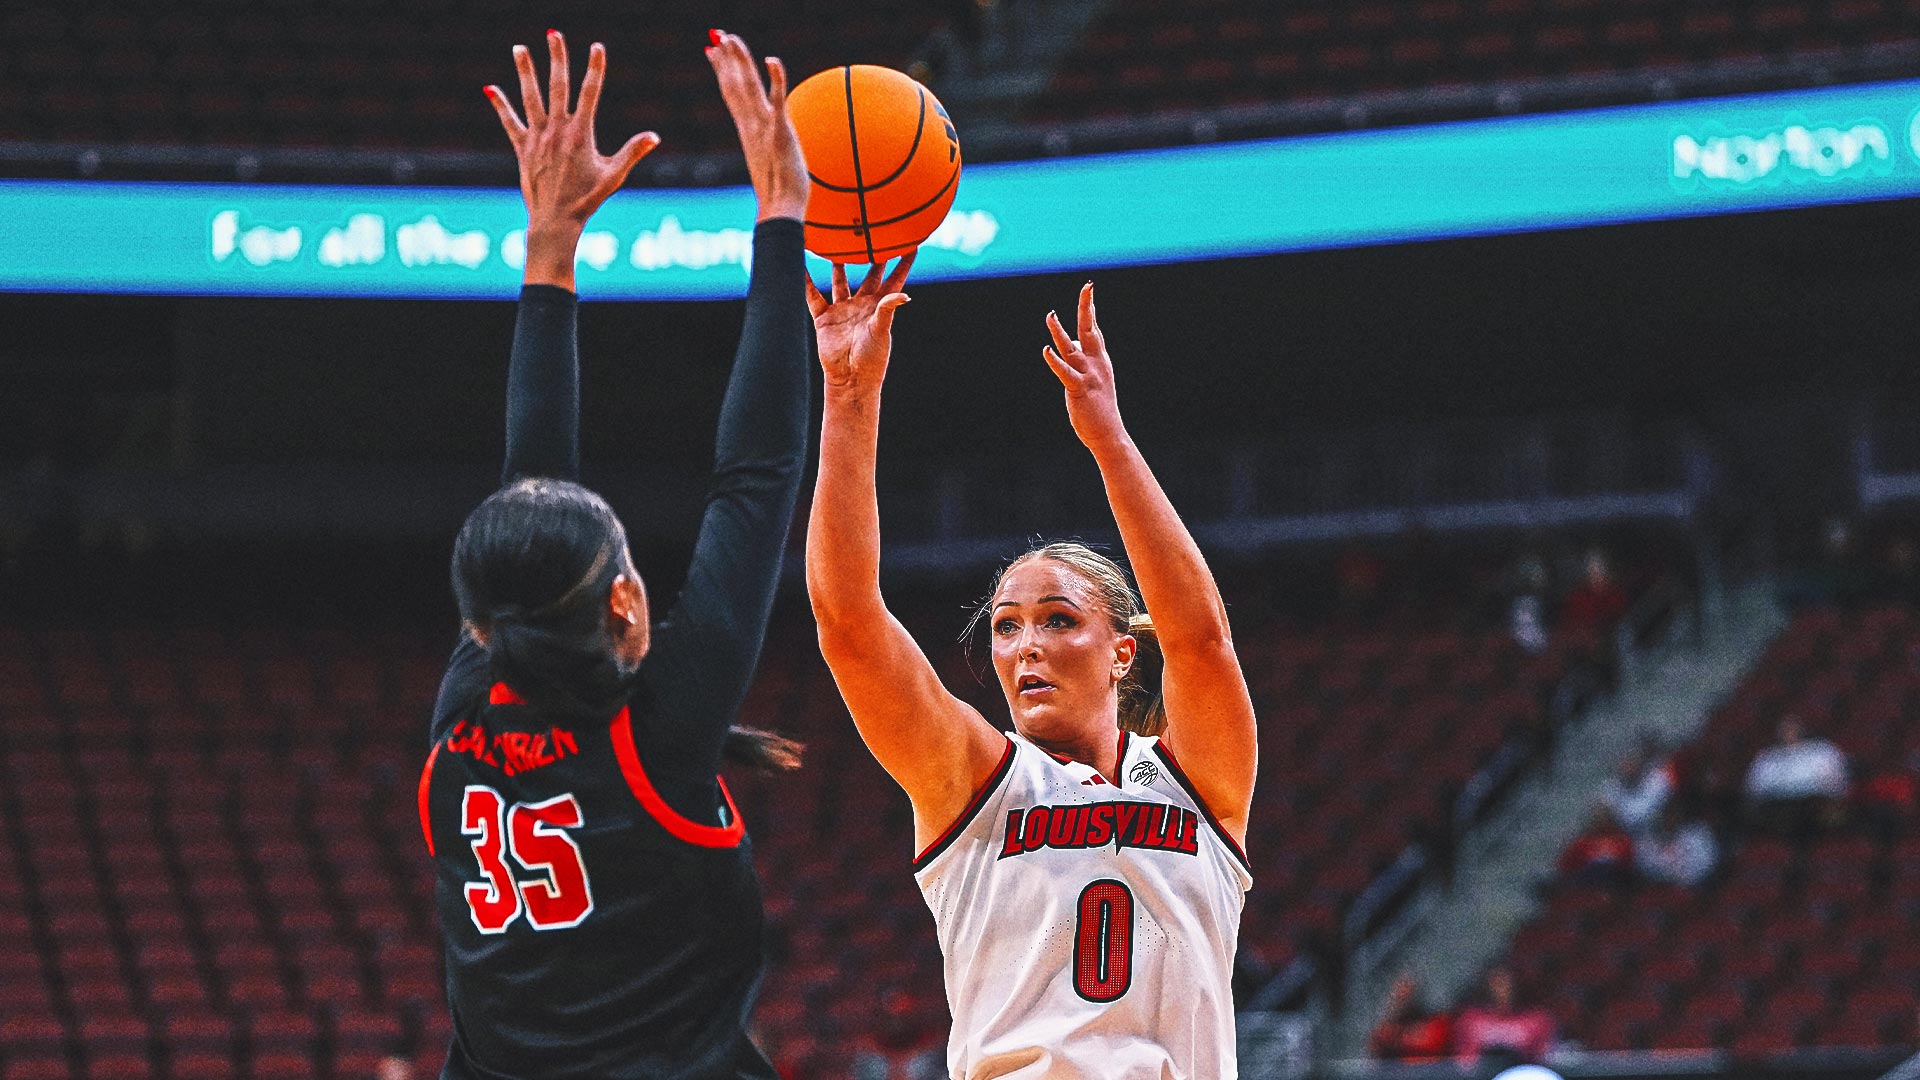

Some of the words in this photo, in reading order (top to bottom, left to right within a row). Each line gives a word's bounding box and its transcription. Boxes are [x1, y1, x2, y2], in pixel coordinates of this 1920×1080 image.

[1673, 124, 1889, 184] Norton
[211, 210, 302, 267] For
[317, 213, 385, 268] all
[396, 214, 490, 270] the
[461, 785, 594, 935] 35
[997, 801, 1199, 861] LOUISVILLE
[1072, 878, 1135, 1003] 0
